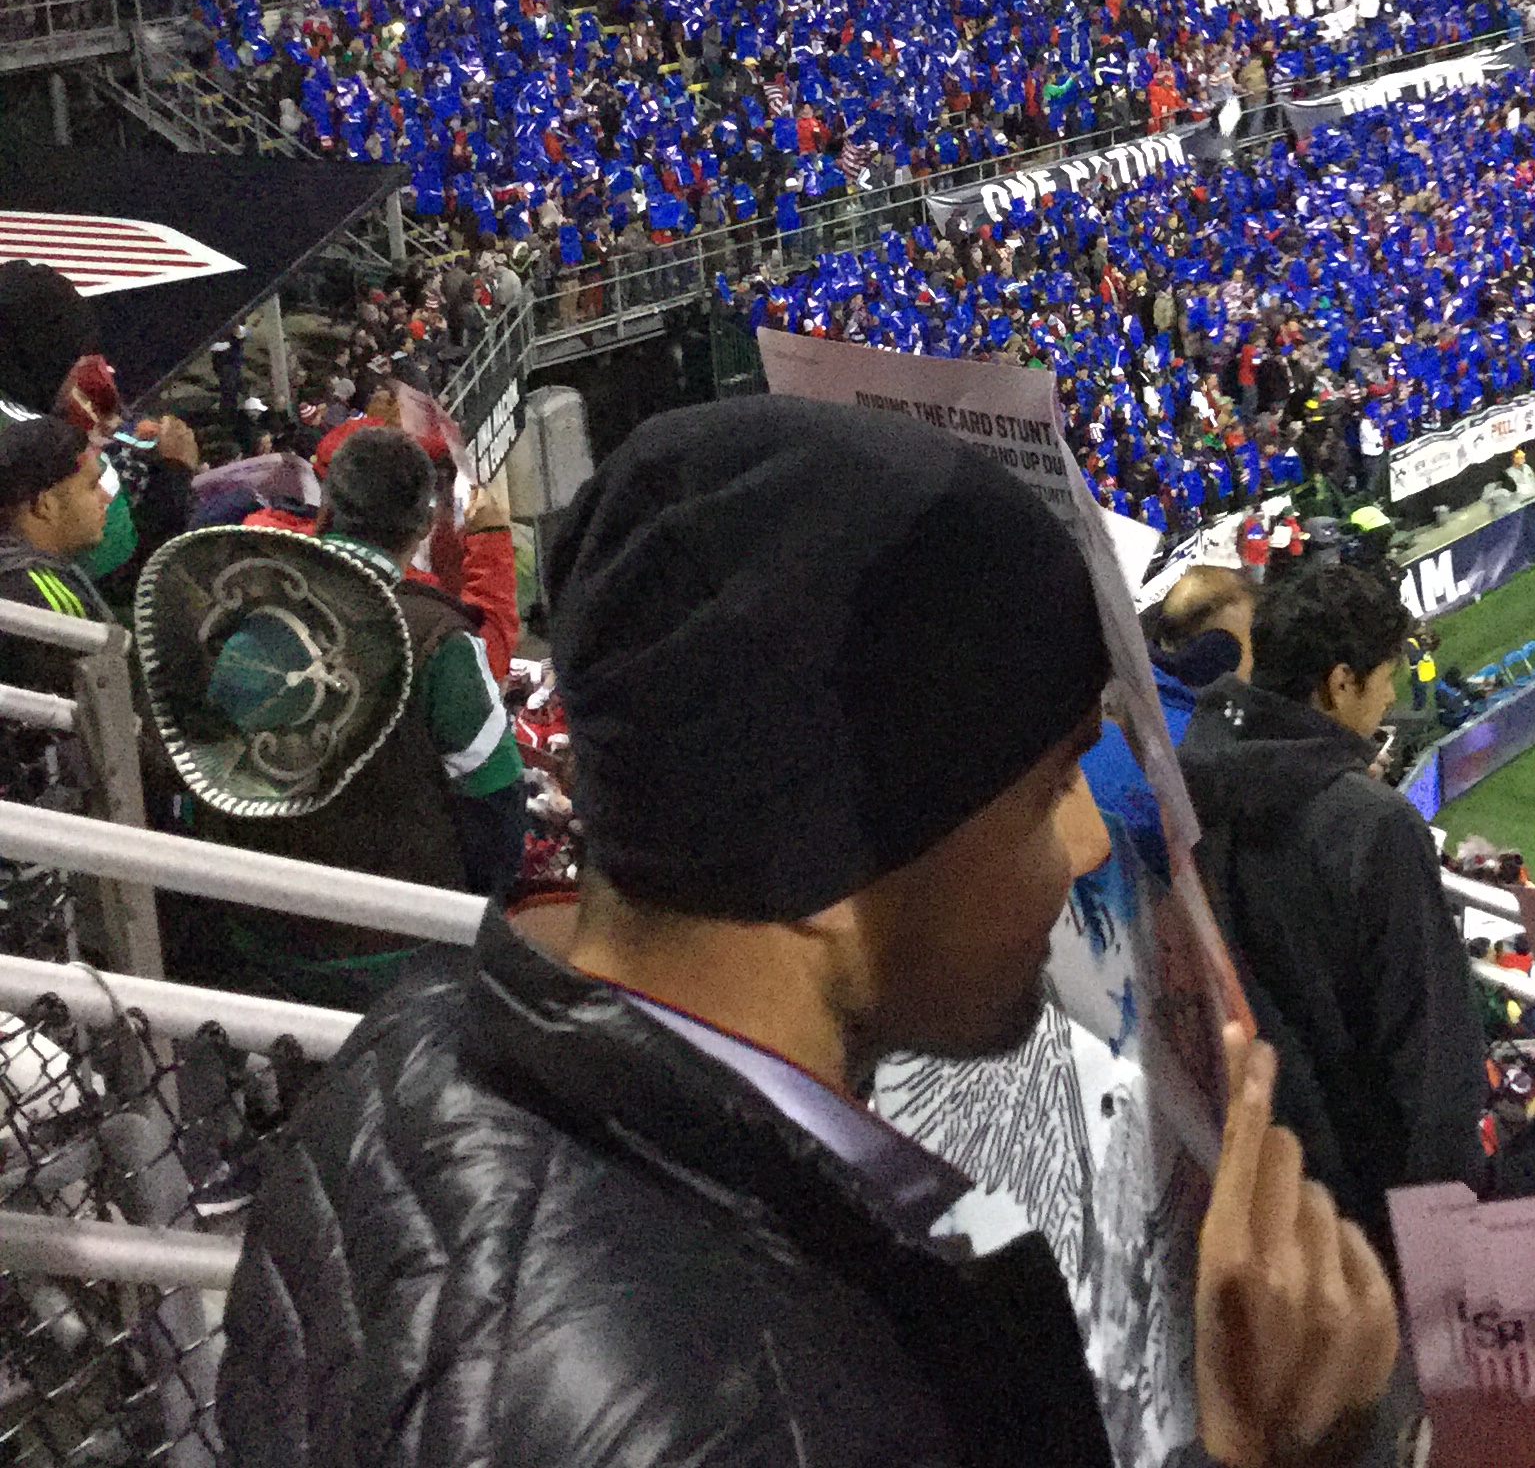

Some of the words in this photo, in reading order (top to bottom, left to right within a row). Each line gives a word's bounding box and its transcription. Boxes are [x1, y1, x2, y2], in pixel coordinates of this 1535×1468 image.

[912, 401, 949, 429] THE
[948, 406, 993, 437] CARD
[1020, 449, 1041, 471] UP
[1400, 549, 1471, 620] AM.
